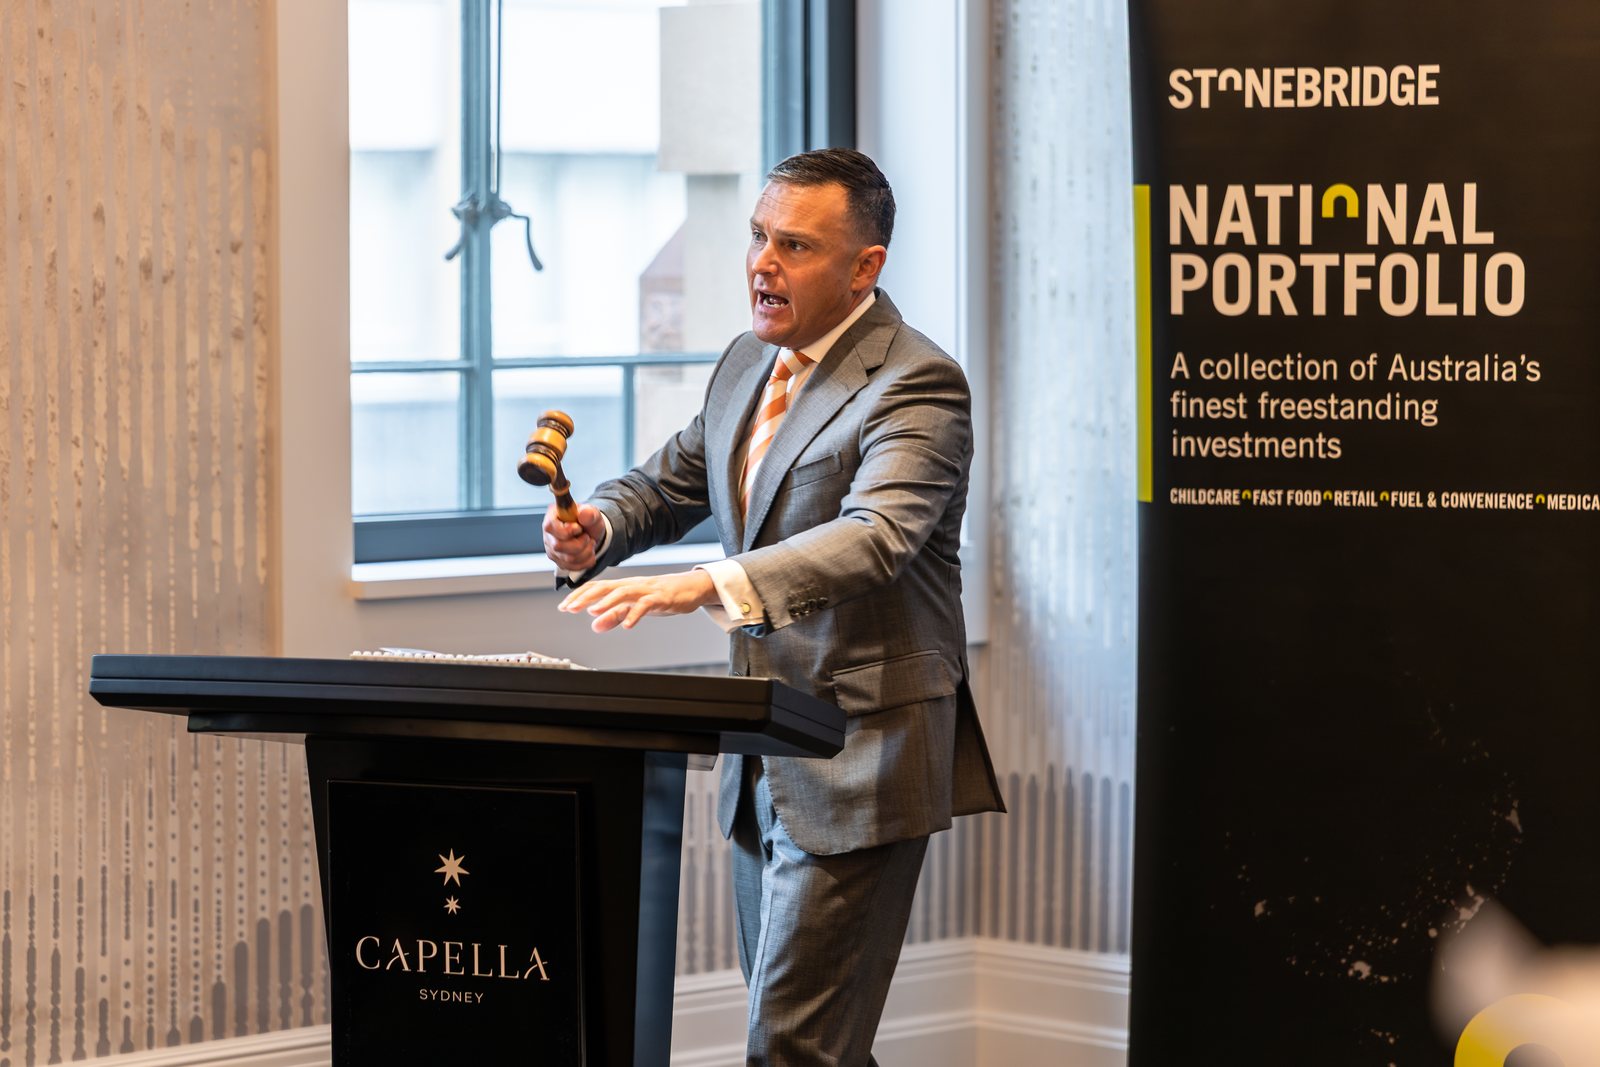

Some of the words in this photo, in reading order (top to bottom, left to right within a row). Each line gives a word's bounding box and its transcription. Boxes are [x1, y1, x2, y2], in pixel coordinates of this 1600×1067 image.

[1170, 251, 1526, 317] PORTFOLIO
[1170, 351, 1190, 379] A
[1199, 352, 1338, 381] collection
[1349, 352, 1378, 381] of
[1387, 353, 1541, 382] Australia’s
[1170, 390, 1248, 419] finest
[1257, 391, 1439, 427] freestanding
[1171, 429, 1342, 459] investments
[1170, 487, 1240, 506] CHILDCARE
[1252, 489, 1284, 506] FAST
[1286, 489, 1322, 506] FOOD
[1333, 490, 1378, 507] RETAIL
[1390, 491, 1424, 508] FUEL
[1426, 491, 1437, 508] &
[1441, 491, 1534, 510] CONVENIENCE
[1546, 493, 1600, 511] MEDICA
[355, 936, 550, 981] CAPELLA
[419, 988, 484, 1004] SYDNEY
